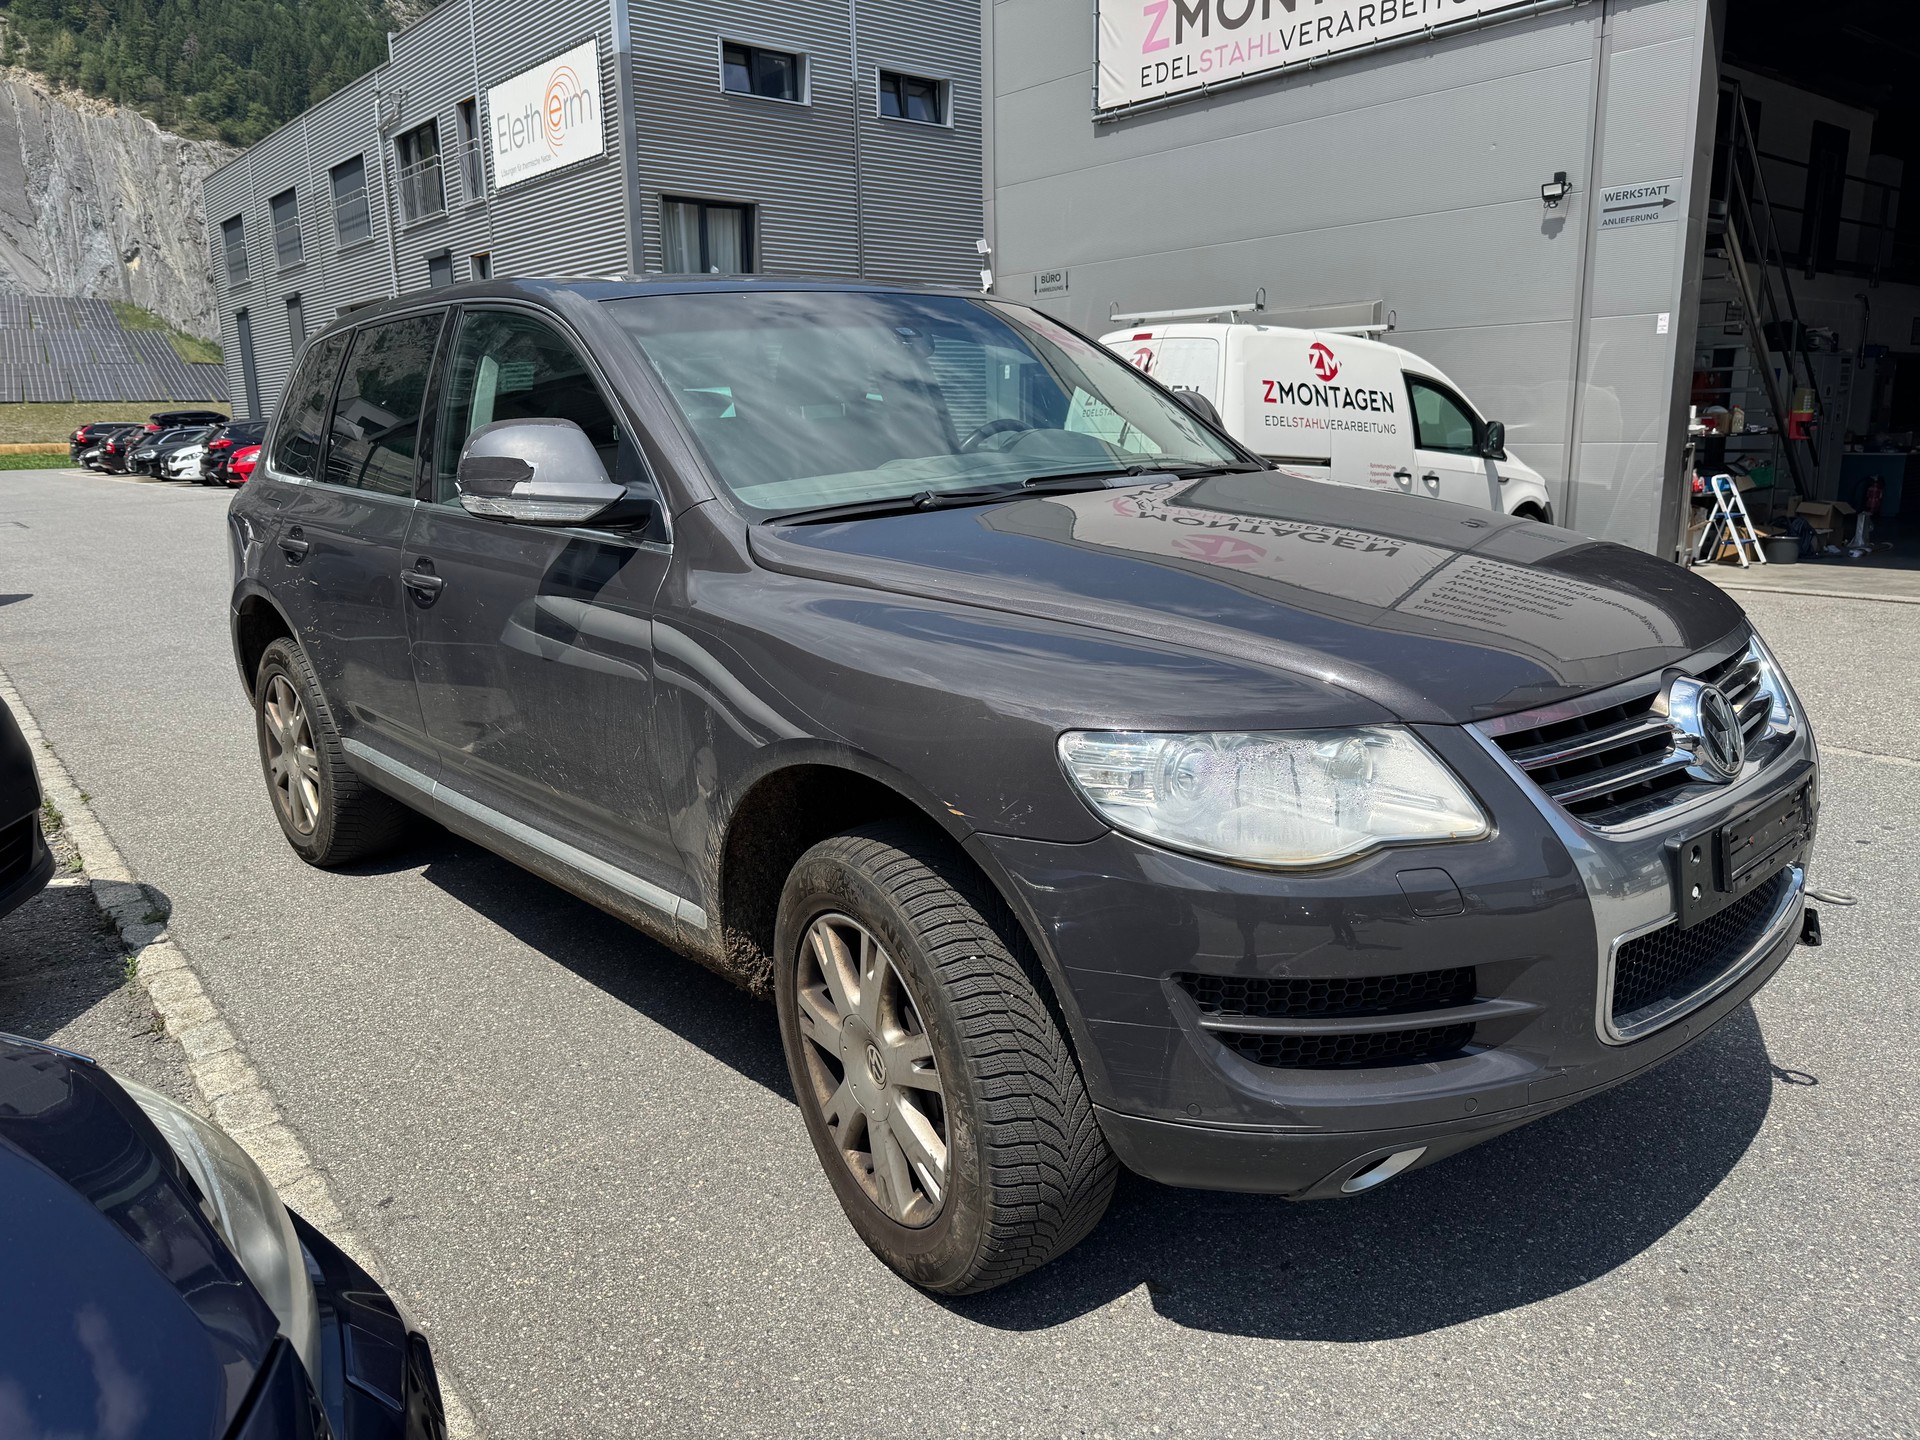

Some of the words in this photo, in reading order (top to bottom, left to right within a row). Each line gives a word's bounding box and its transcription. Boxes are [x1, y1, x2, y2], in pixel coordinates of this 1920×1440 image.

[496, 89, 593, 156] Eletherm
[1604, 184, 1670, 203] WERKSTATT
[1602, 212, 1659, 226] ANLIEFERUNG
[1041, 272, 1062, 284] BÜRO
[1262, 379, 1395, 413] ZMONTAGEN
[1264, 415, 1397, 435] EDELSTAHLVERARBEITUNG
